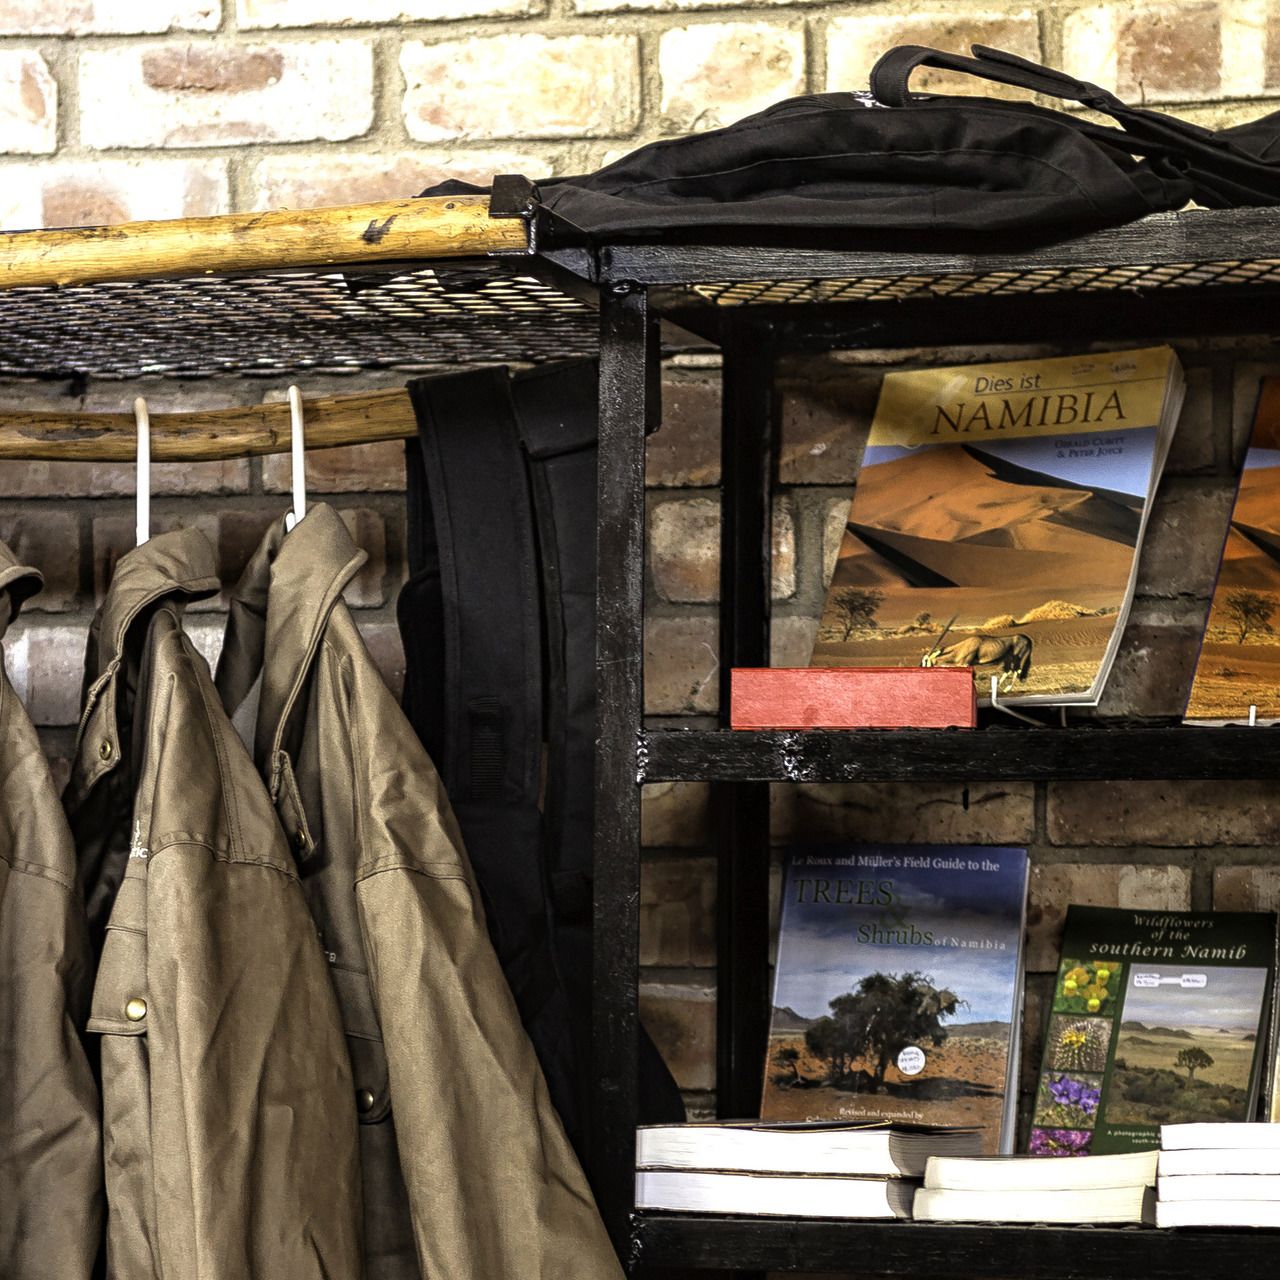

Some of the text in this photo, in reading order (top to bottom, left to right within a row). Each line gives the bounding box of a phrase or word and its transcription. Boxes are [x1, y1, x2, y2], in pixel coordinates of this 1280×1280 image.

[974, 373, 1041, 393] Dies ist
[930, 389, 1126, 435] NAMIBIA
[835, 856, 855, 866] and
[904, 857, 930, 869] Field
[933, 858, 966, 870] Guide
[967, 860, 980, 871] to
[981, 860, 1000, 872] the
[793, 879, 894, 906] TREES
[1134, 914, 1215, 929] Wildflowers
[857, 924, 1006, 950] Shrubs of Namibia
[1151, 928, 1190, 941] of the
[1090, 941, 1247, 960] southern Namib
